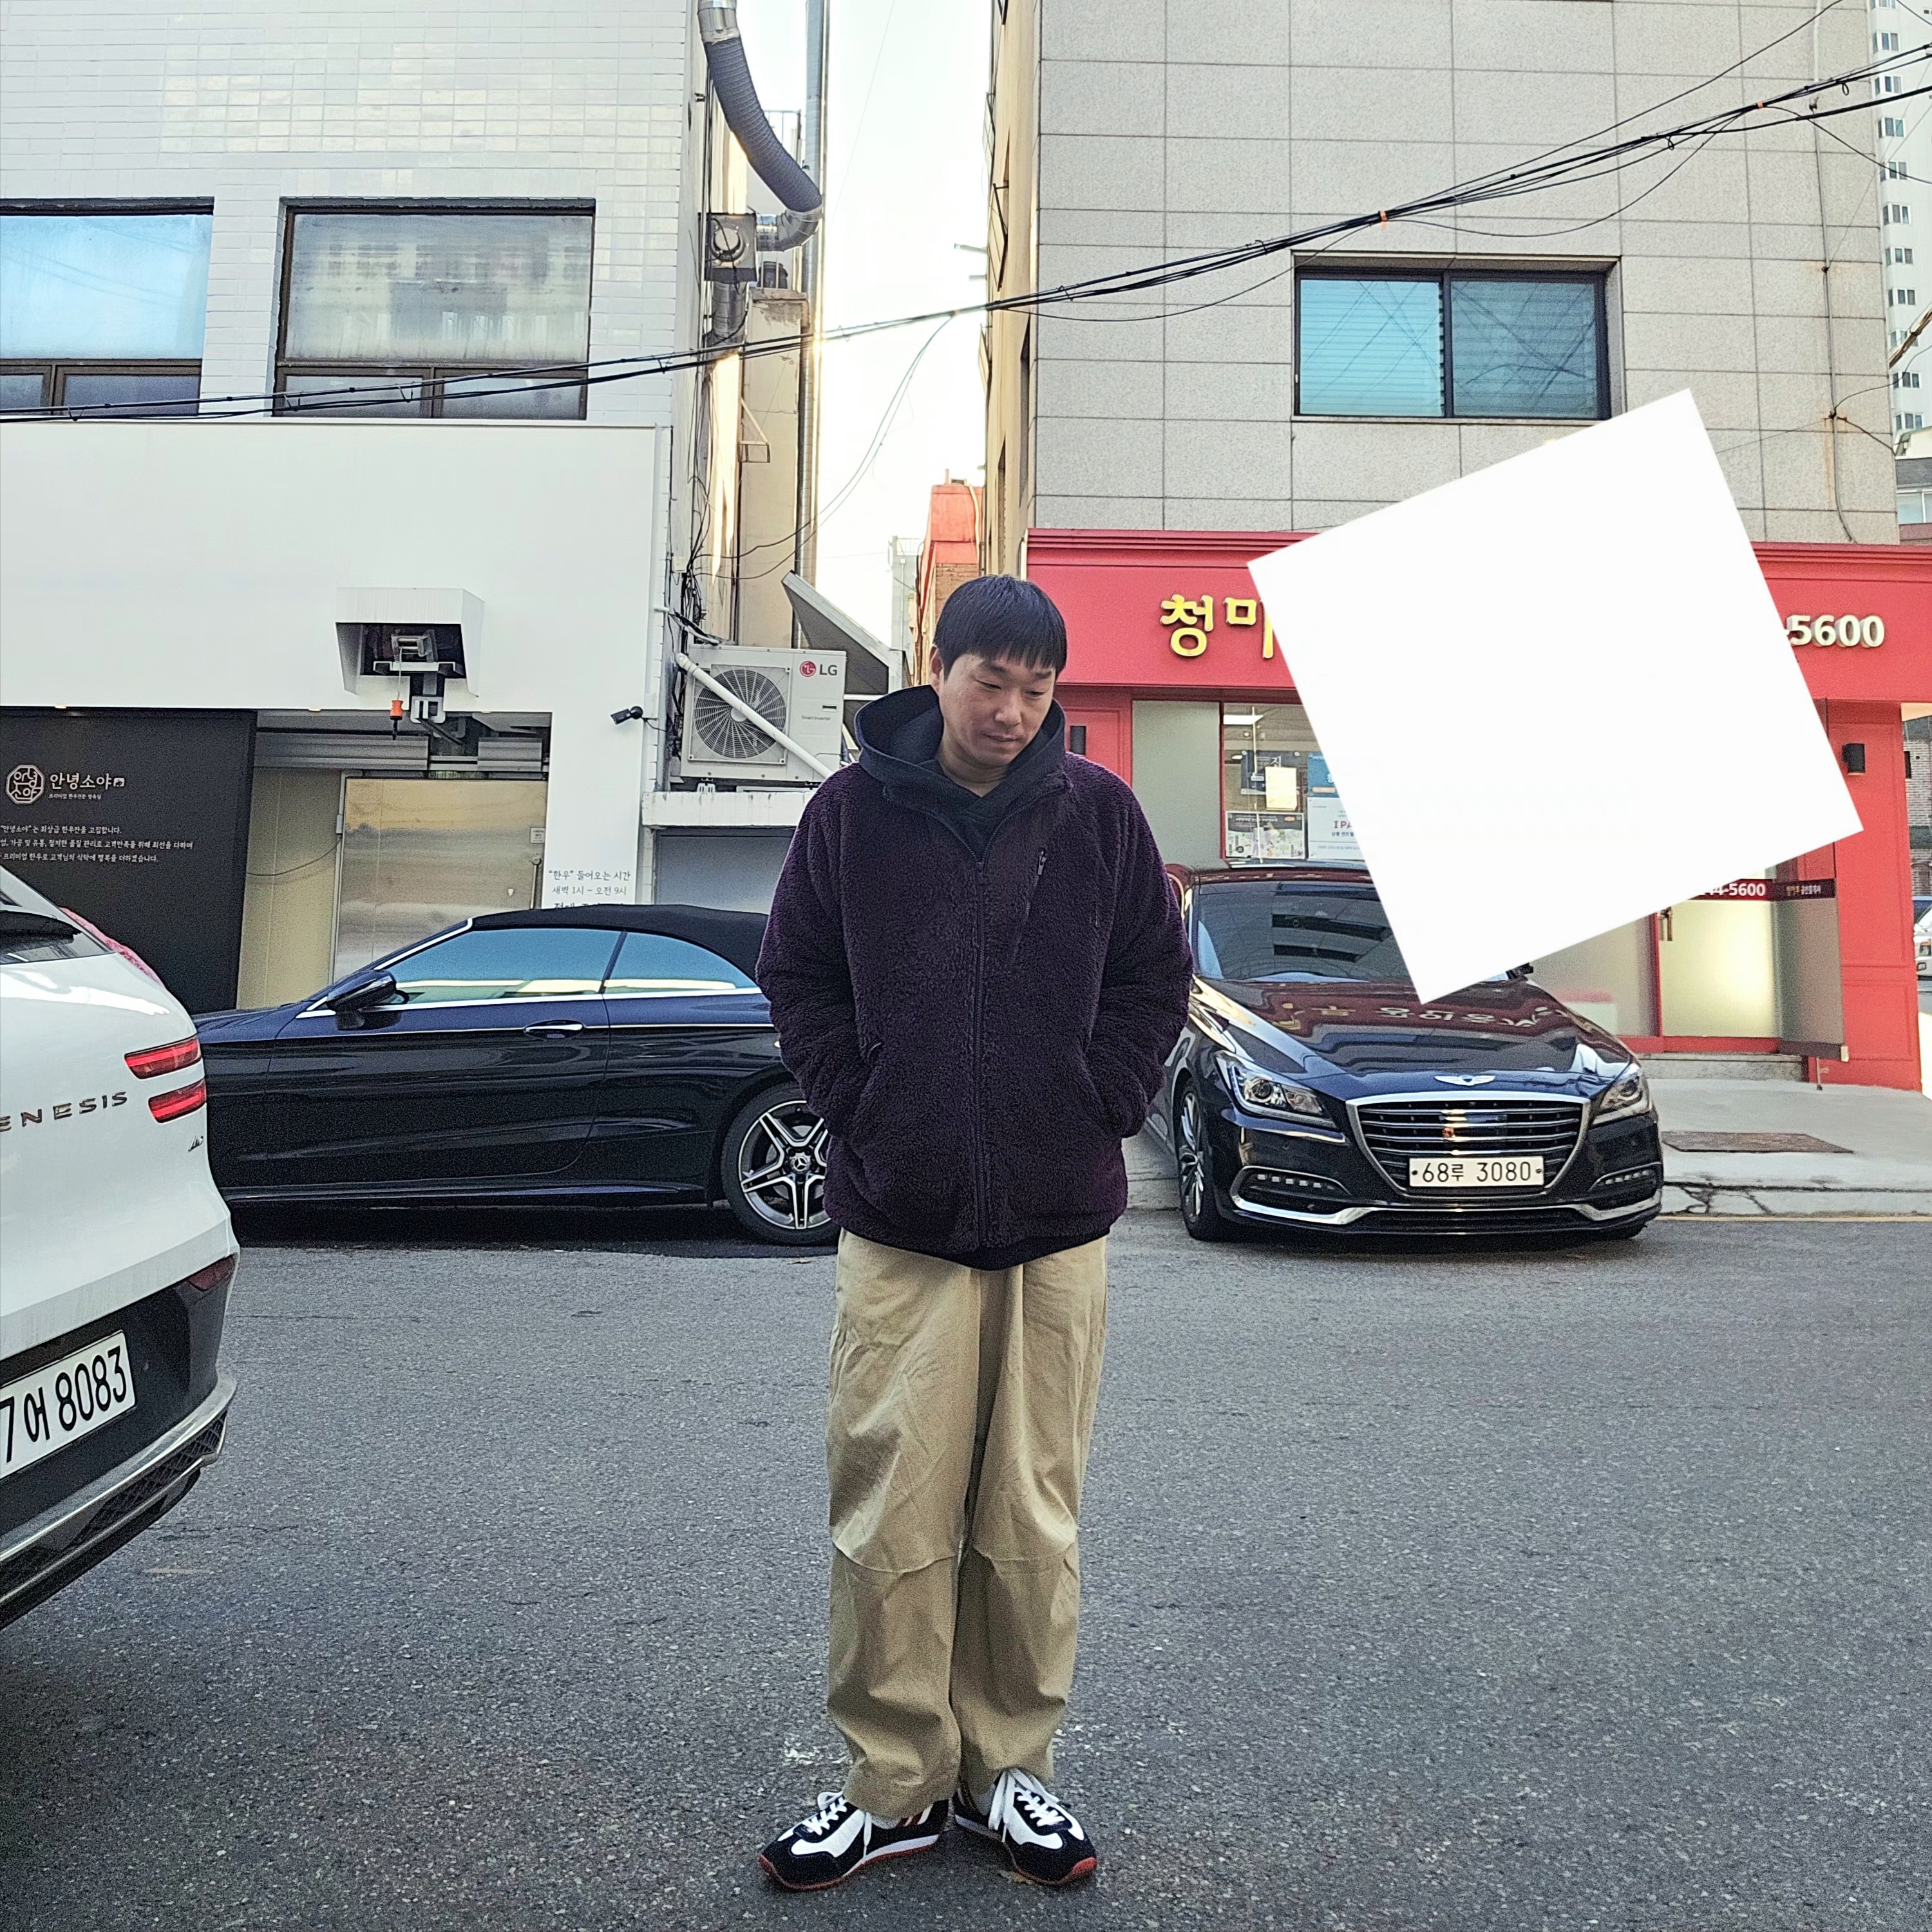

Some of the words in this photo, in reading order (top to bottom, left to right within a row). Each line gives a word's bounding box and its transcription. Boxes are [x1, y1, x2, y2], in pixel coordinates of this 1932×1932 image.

[819, 664, 838, 676] LG
[50, 773, 112, 790] 안녕소야
[41, 826, 60, 834] 최상급
[61, 826, 87, 834] 한우만을
[88, 826, 122, 835] 고집합니다.
[10, 838, 23, 847] 가공
[32, 839, 47, 848] 유통,
[70, 839, 82, 848] 품질
[83, 840, 103, 848] 관리로
[104, 840, 137, 849] 고객만족을
[138, 840, 151, 849] 위해
[152, 840, 171, 849] 최선을
[3, 852, 27, 862] 프리미엄
[29, 852, 48, 861] 한우로
[50, 853, 75, 862] 고객님의
[77, 853, 96, 862] 식탁에
[97, 854, 117, 863] 행복을
[576, 870, 611, 881] 들어오는
[613, 871, 631, 882] 시간
[553, 886, 569, 896] 새벽
[572, 886, 584, 896] 1시
[595, 886, 612, 896] 오전
[614, 886, 627, 896] 9시
[1423, 1162, 1464, 1182] 68루
[1477, 1161, 1531, 1182] 3080
[55, 1345, 127, 1432] 8083
